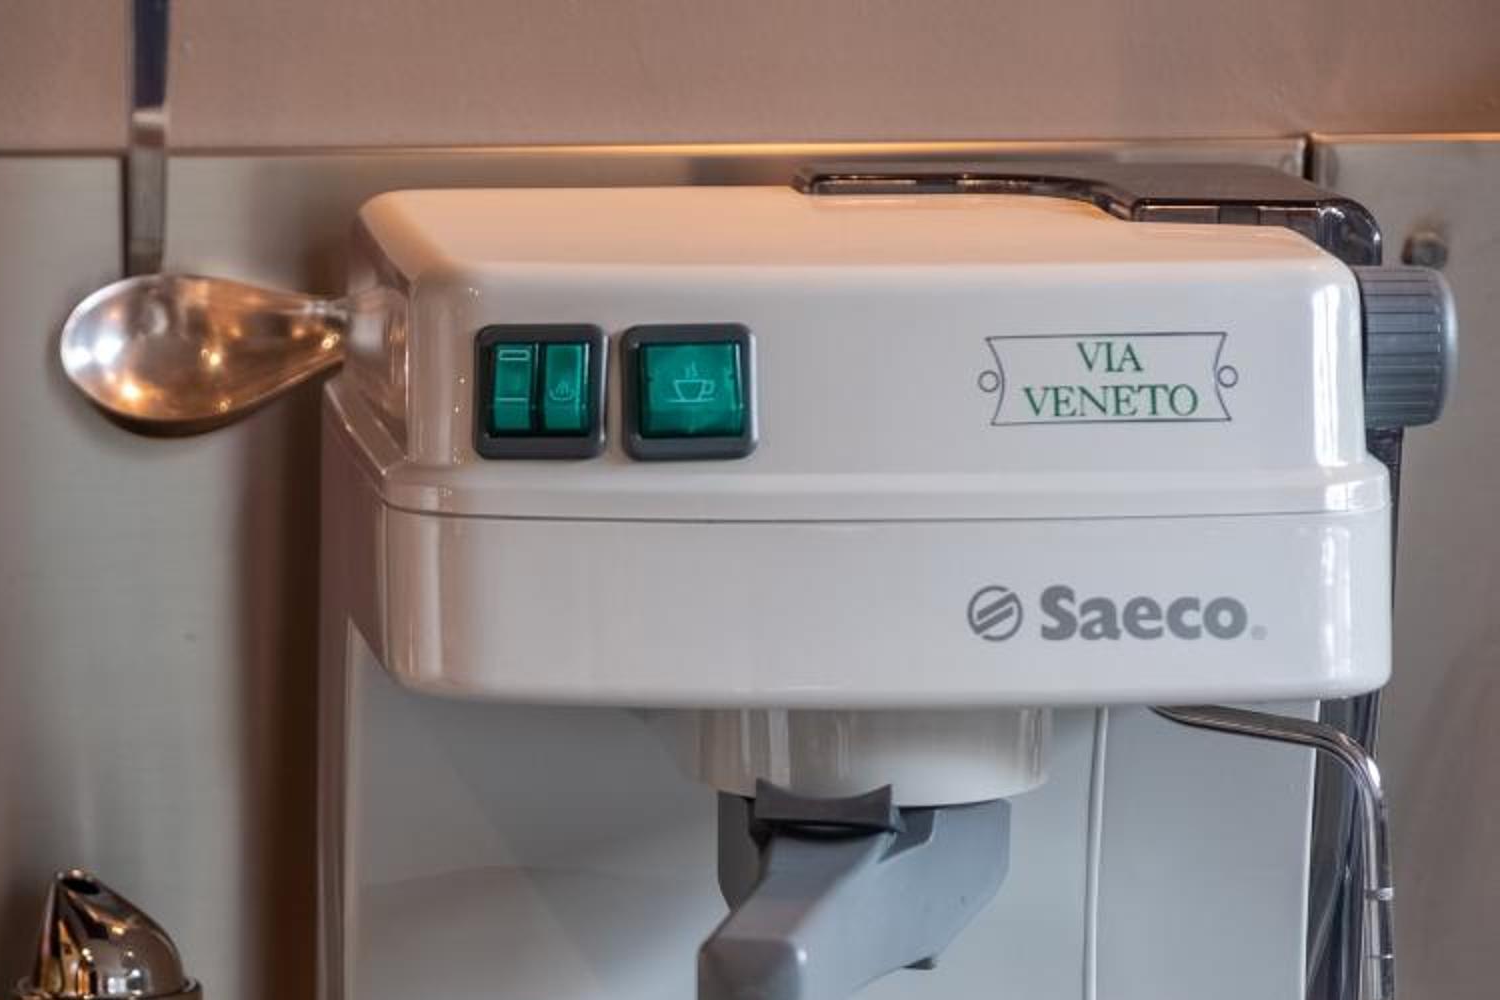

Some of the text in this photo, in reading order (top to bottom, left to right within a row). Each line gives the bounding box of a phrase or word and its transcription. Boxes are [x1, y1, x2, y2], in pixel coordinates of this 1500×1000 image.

[1077, 341, 1144, 373] VIA
[1023, 383, 1199, 417] VENETO
[1040, 584, 1249, 641] Saeco
